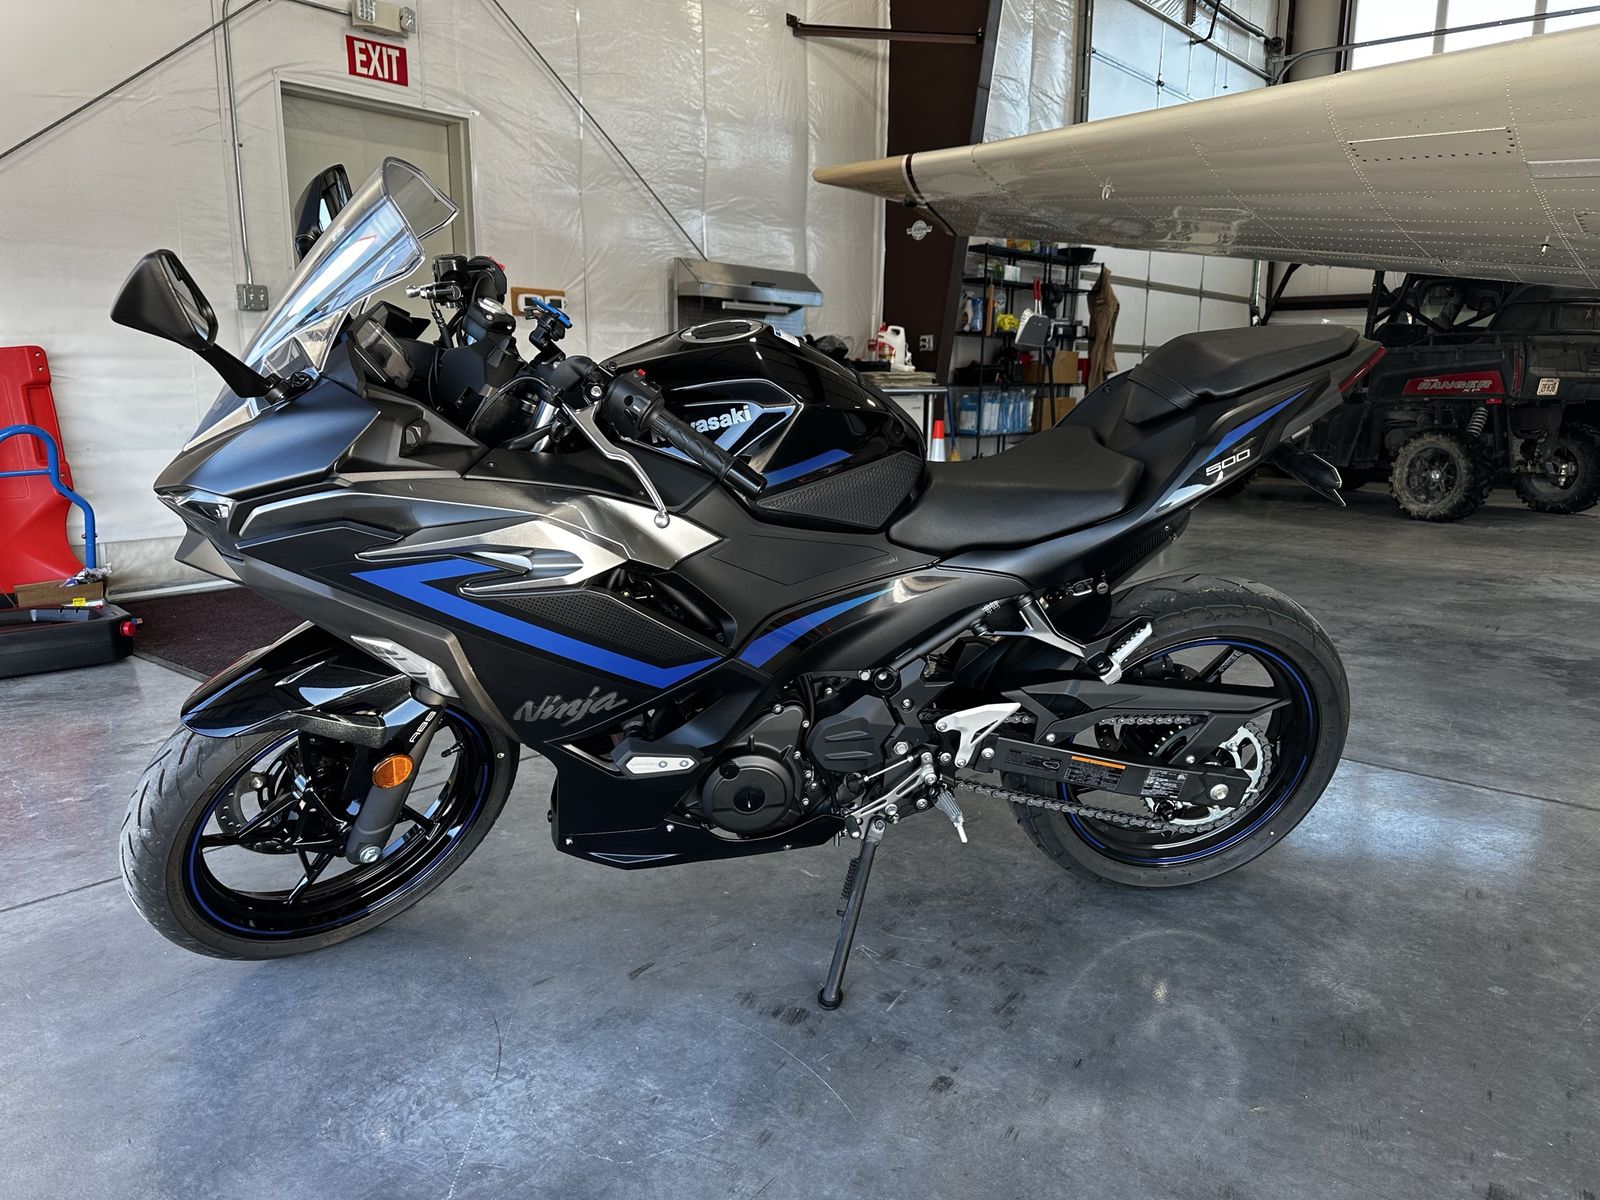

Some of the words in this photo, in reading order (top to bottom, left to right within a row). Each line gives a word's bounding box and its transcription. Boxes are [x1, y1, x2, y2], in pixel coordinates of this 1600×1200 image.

[353, 40, 400, 82] EXIT
[1417, 379, 1493, 391] RANGER
[1205, 448, 1251, 477] 500
[512, 686, 628, 727] Ninja
[408, 710, 437, 743] ABS
